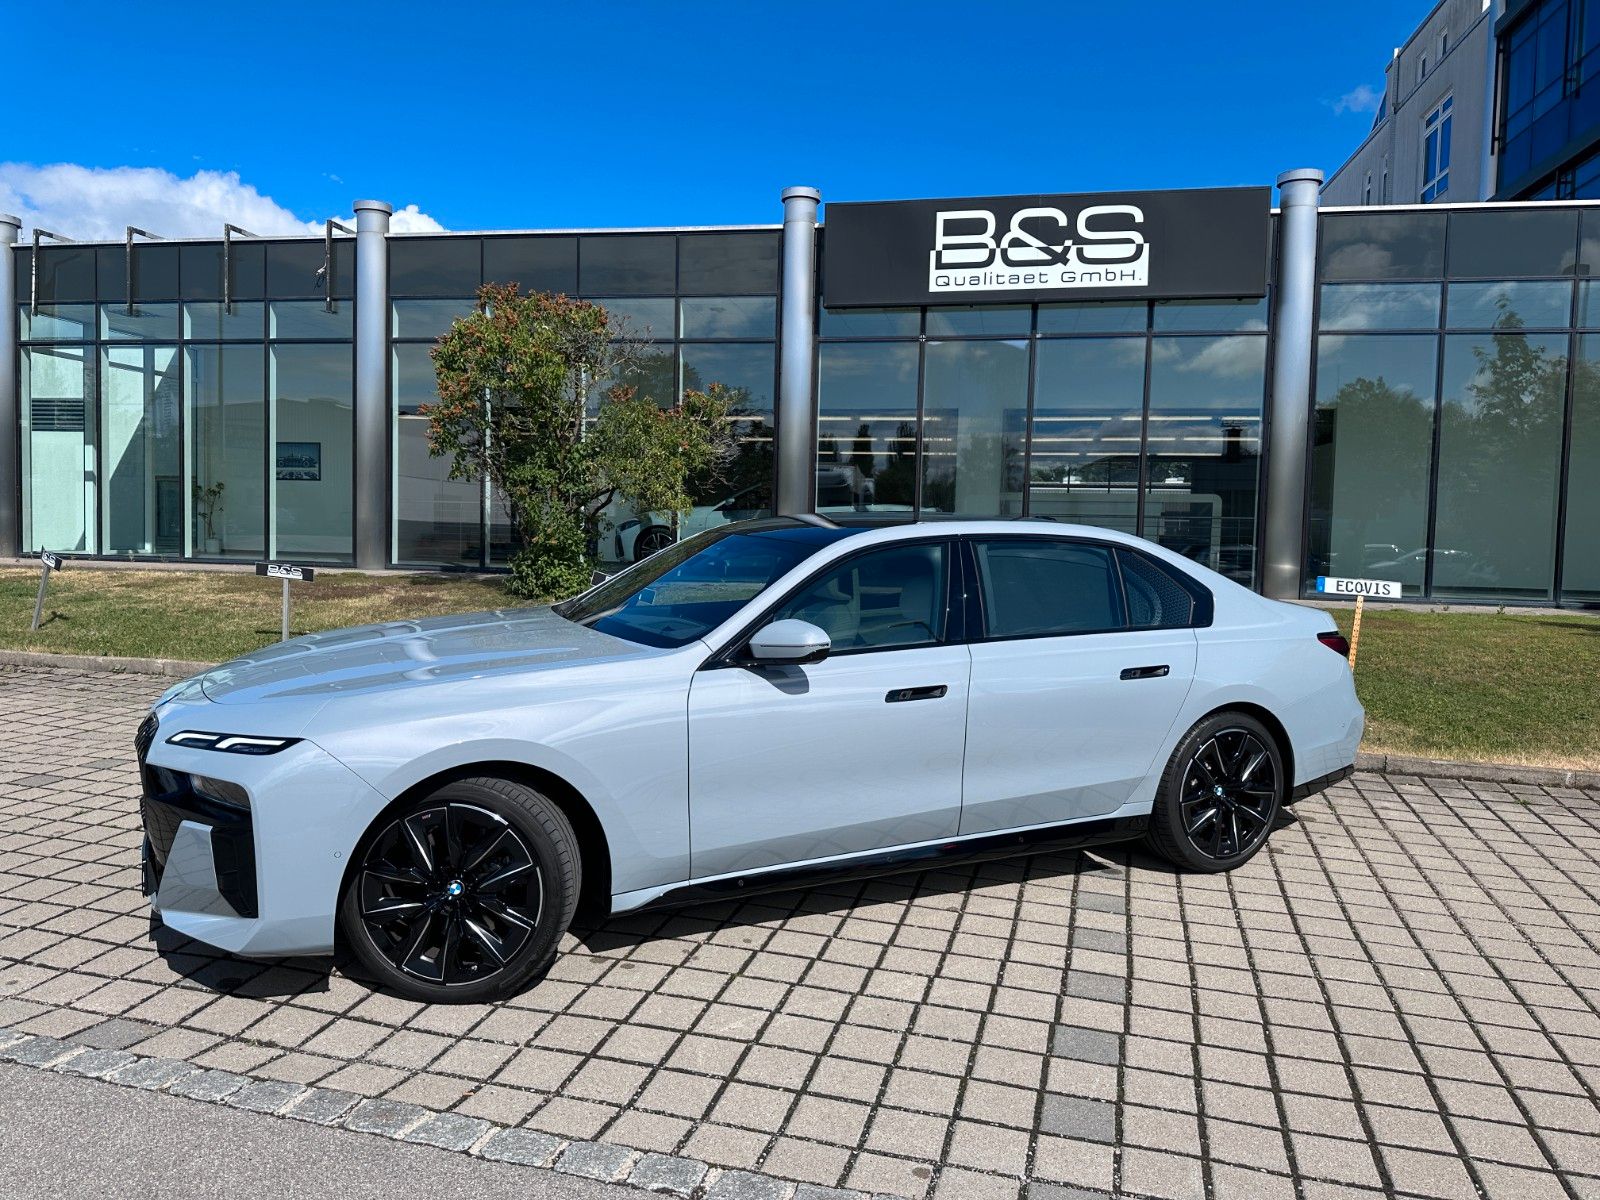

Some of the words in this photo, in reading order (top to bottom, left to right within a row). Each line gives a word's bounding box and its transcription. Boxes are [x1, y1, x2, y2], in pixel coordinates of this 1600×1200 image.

[935, 205, 1144, 270] B&S
[936, 272, 1048, 287] Qualitaet
[1061, 269, 1142, 283] GmbH.
[1336, 580, 1391, 595] ECOVIS
